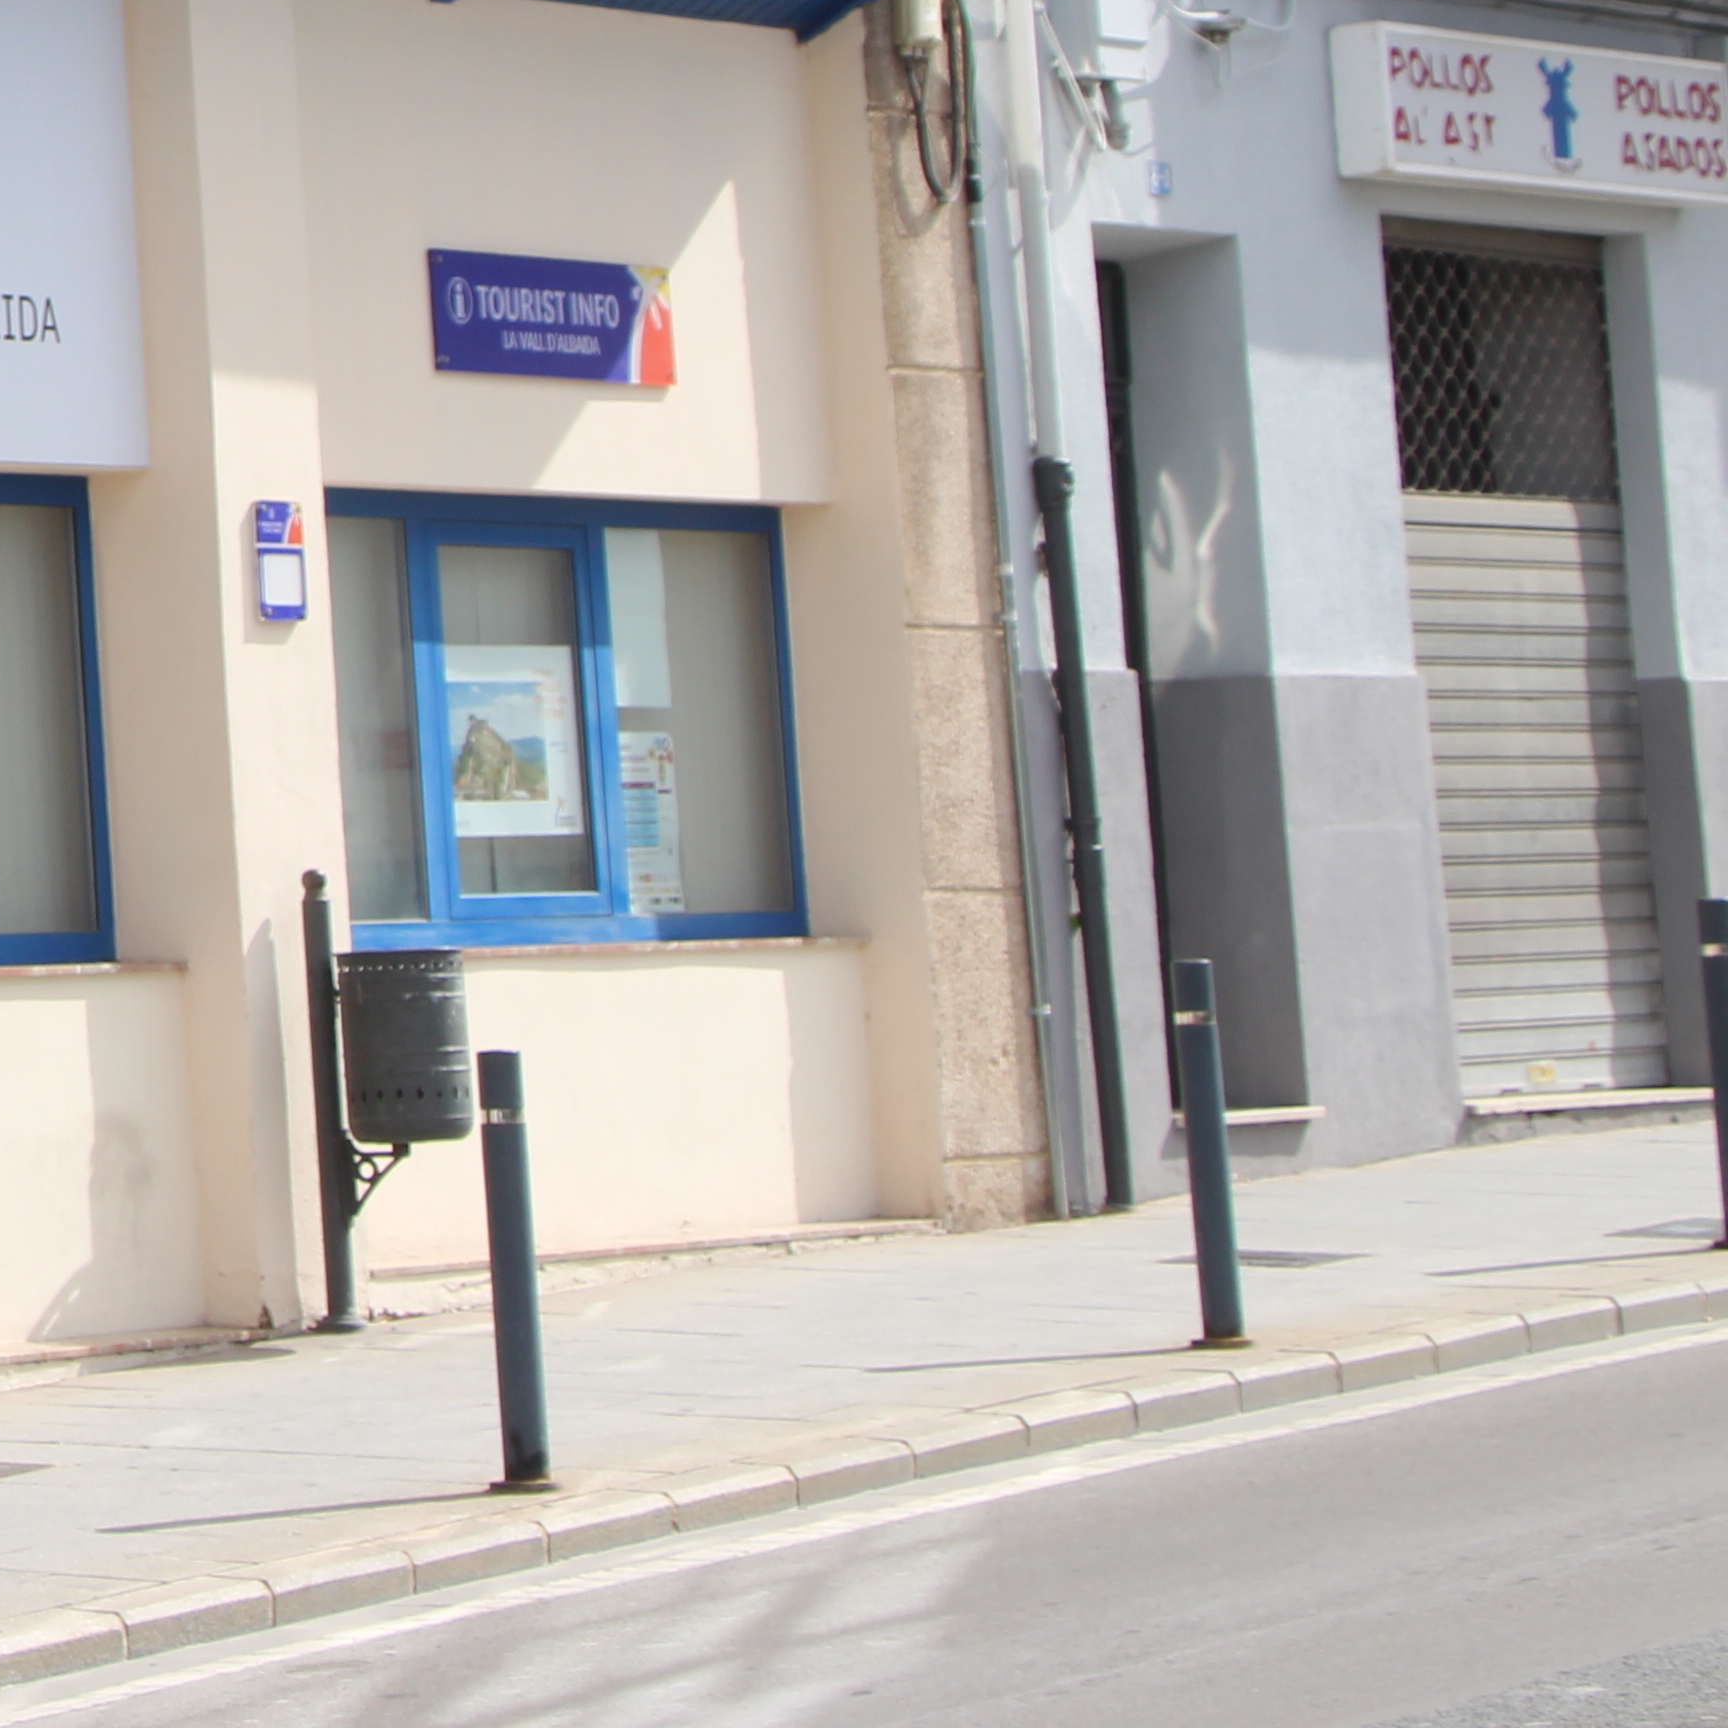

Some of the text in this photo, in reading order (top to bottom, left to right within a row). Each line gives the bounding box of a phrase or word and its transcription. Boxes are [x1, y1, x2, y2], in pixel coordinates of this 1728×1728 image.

[1388, 46, 1495, 96] POLLOS
[1614, 73, 1722, 124] POLLOS
[1621, 132, 1726, 179] ASADOS
[475, 284, 566, 325] TOURIST
[569, 291, 621, 330] INFO
[501, 329, 602, 355] LA VALL D'ALBAIDA
